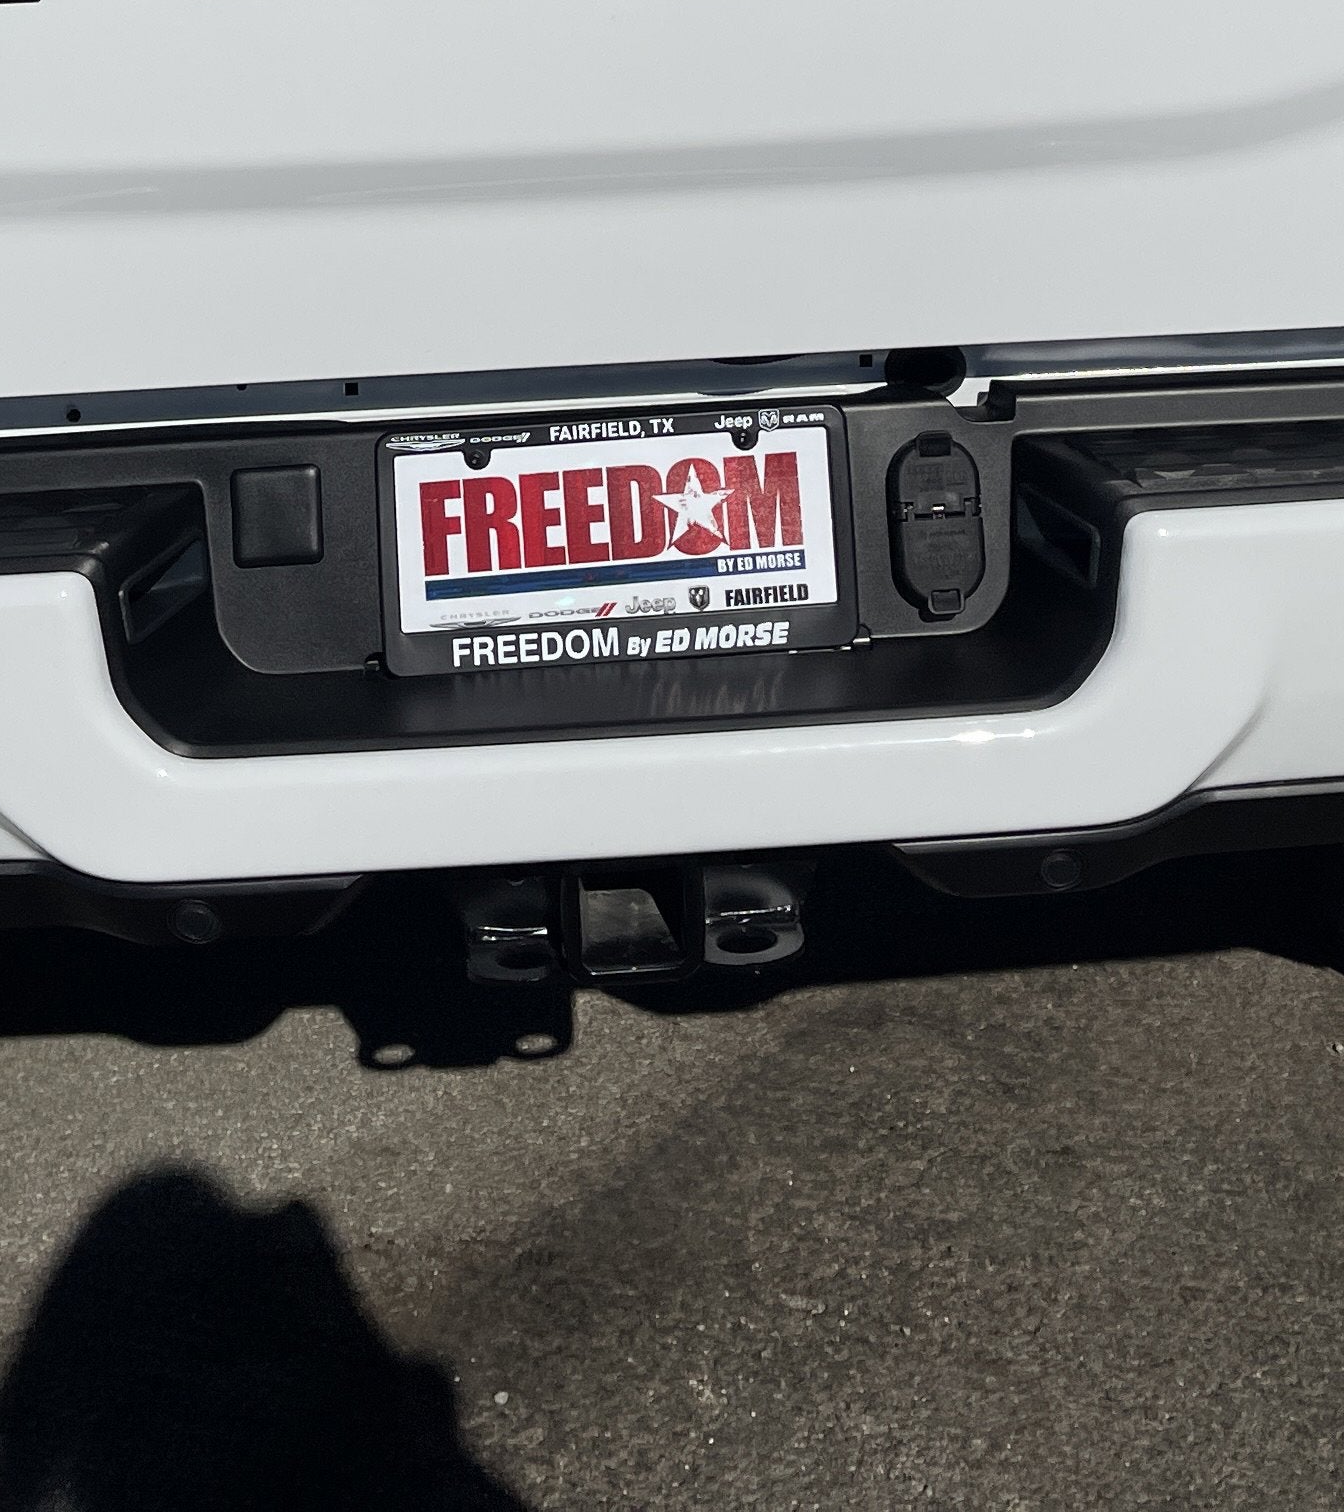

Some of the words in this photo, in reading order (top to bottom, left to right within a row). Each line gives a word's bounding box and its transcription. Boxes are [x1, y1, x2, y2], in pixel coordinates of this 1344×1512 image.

[390, 432, 460, 443] CHRYSLER
[549, 420, 645, 442] FAIRFIELD,
[649, 418, 674, 434] TX
[714, 414, 753, 430] Jeep
[782, 413, 825, 423] RAM
[419, 451, 804, 576] FREEDOM
[717, 558, 735, 573] BY
[737, 557, 754, 571] ED
[756, 552, 802, 570] MORSE
[440, 609, 511, 621] CHRYSLER
[625, 595, 677, 615] Jeep
[725, 583, 810, 608] FAIRFIELD
[452, 627, 620, 668] FREEDOM
[627, 635, 651, 658] By
[654, 627, 691, 654] ED
[694, 621, 790, 651] MORSE
